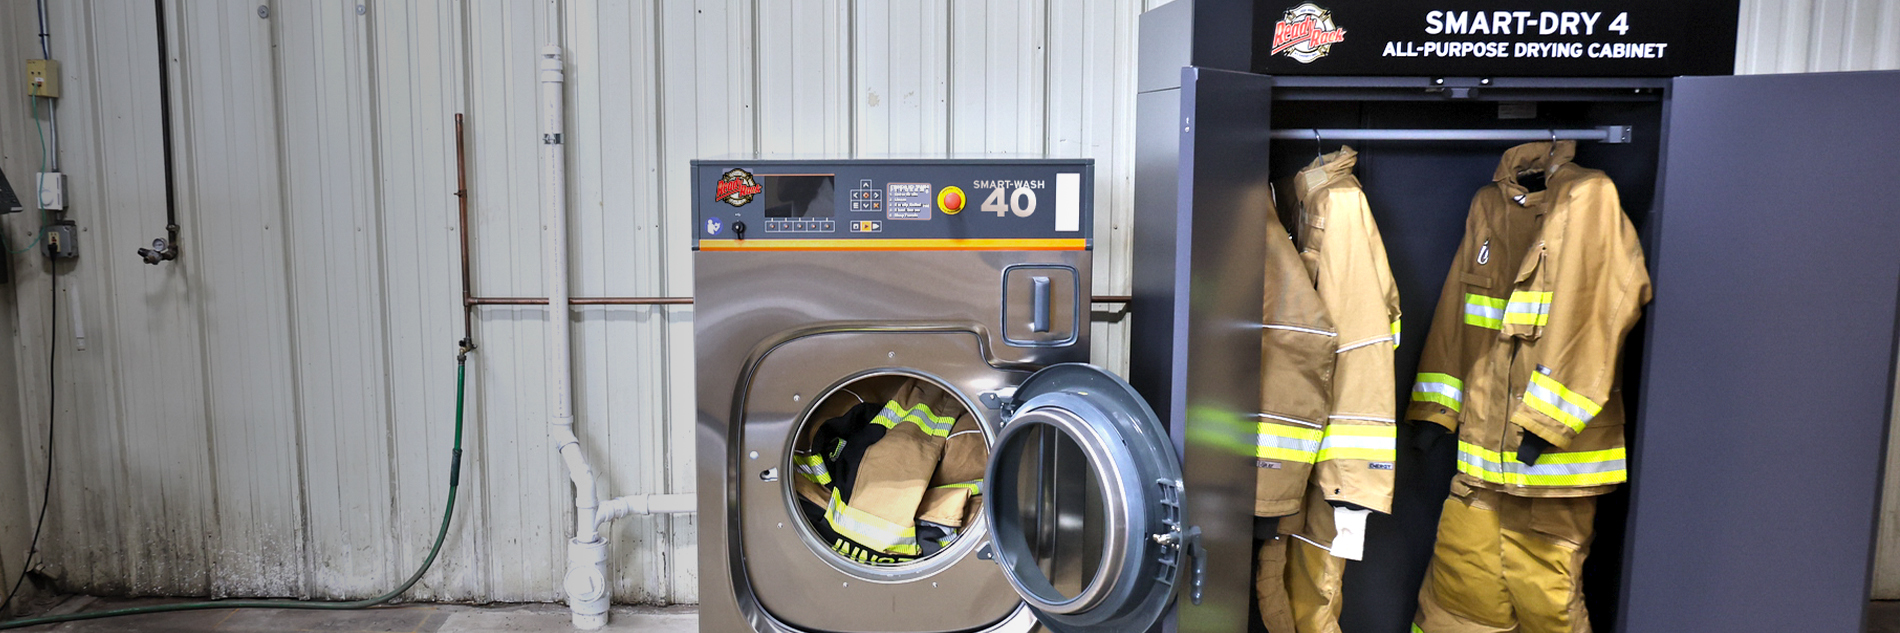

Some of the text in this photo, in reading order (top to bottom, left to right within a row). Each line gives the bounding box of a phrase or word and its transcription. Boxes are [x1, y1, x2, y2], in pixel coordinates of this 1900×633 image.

[1271, 14, 1347, 55] Ready Rack
[1425, 10, 1630, 35] SMART-DRY 4
[1382, 41, 1668, 59] ALL-PURPOSE DRYING CABINET
[715, 176, 743, 202] Ready
[973, 180, 1045, 189] SMART-WASH
[980, 187, 1037, 218] 40
[832, 537, 915, 566] INN
